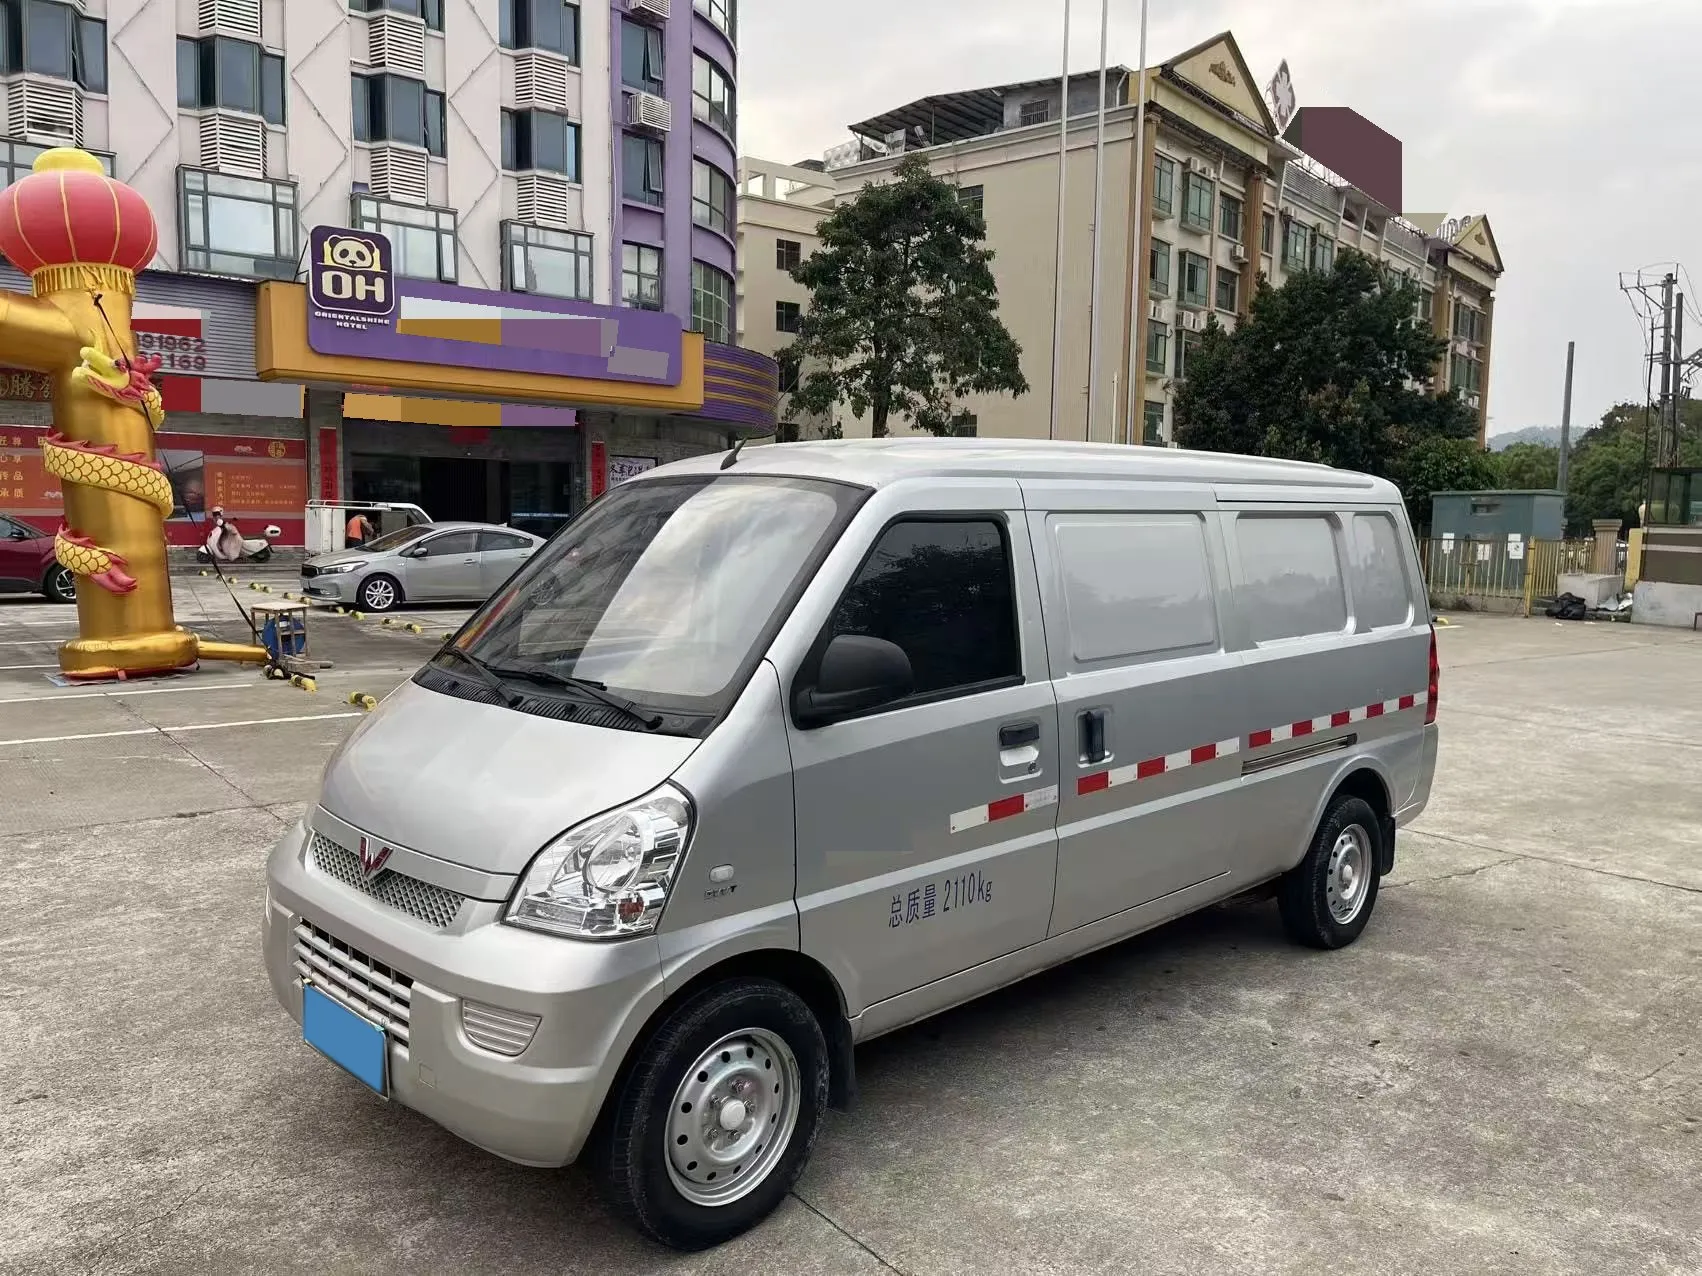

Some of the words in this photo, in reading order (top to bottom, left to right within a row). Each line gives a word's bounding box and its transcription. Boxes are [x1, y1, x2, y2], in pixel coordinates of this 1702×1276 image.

[321, 270, 385, 303] OH
[314, 310, 390, 325] ORIENTALSHINE
[336, 320, 368, 330] HOTEL
[888, 883, 937, 928] 总质量
[942, 869, 993, 913] 2110kg
